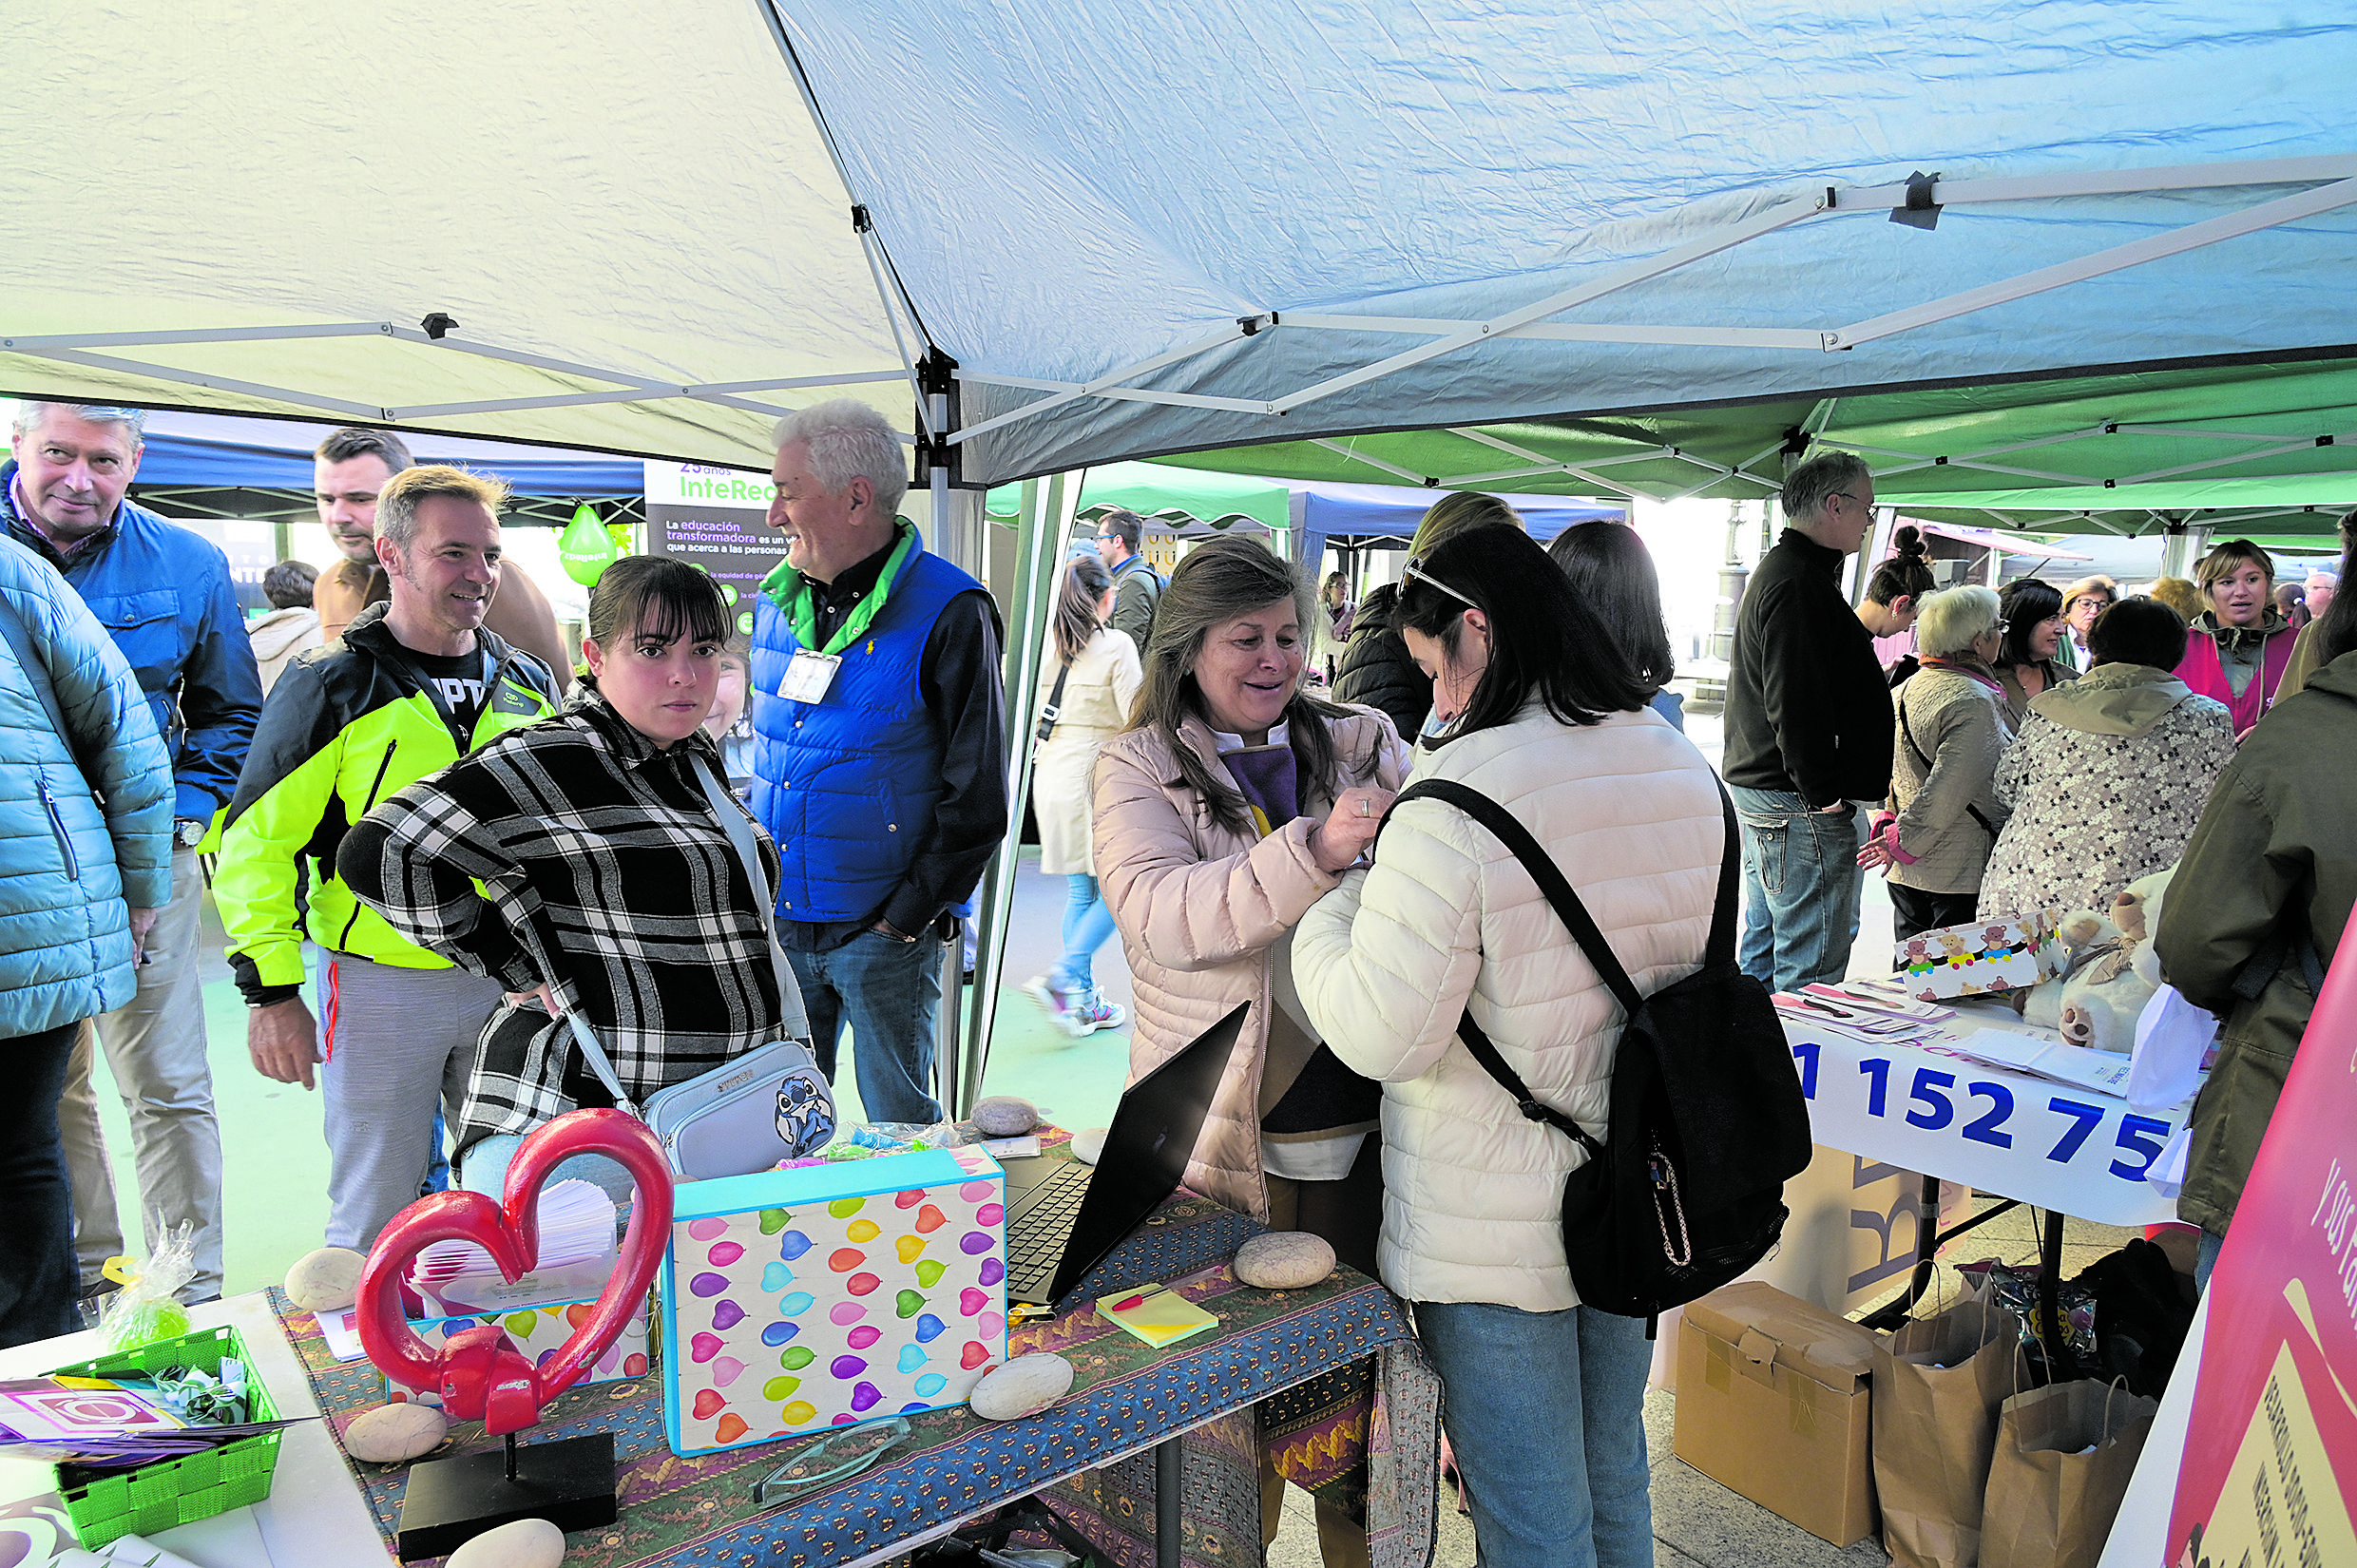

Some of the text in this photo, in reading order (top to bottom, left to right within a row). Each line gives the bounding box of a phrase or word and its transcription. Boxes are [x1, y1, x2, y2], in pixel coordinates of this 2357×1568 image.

[666, 520, 740, 532] La educación
[666, 530, 757, 544] transformadora
[758, 536, 770, 545] es
[772, 536, 784, 545] un
[666, 543, 686, 552] que
[687, 545, 719, 553] acerca
[729, 545, 743, 554] las
[744, 546, 788, 556] personas
[1859, 1057, 2015, 1150] 152
[2045, 1096, 2172, 1183] 75
[2324, 1179, 2356, 1255] sus
